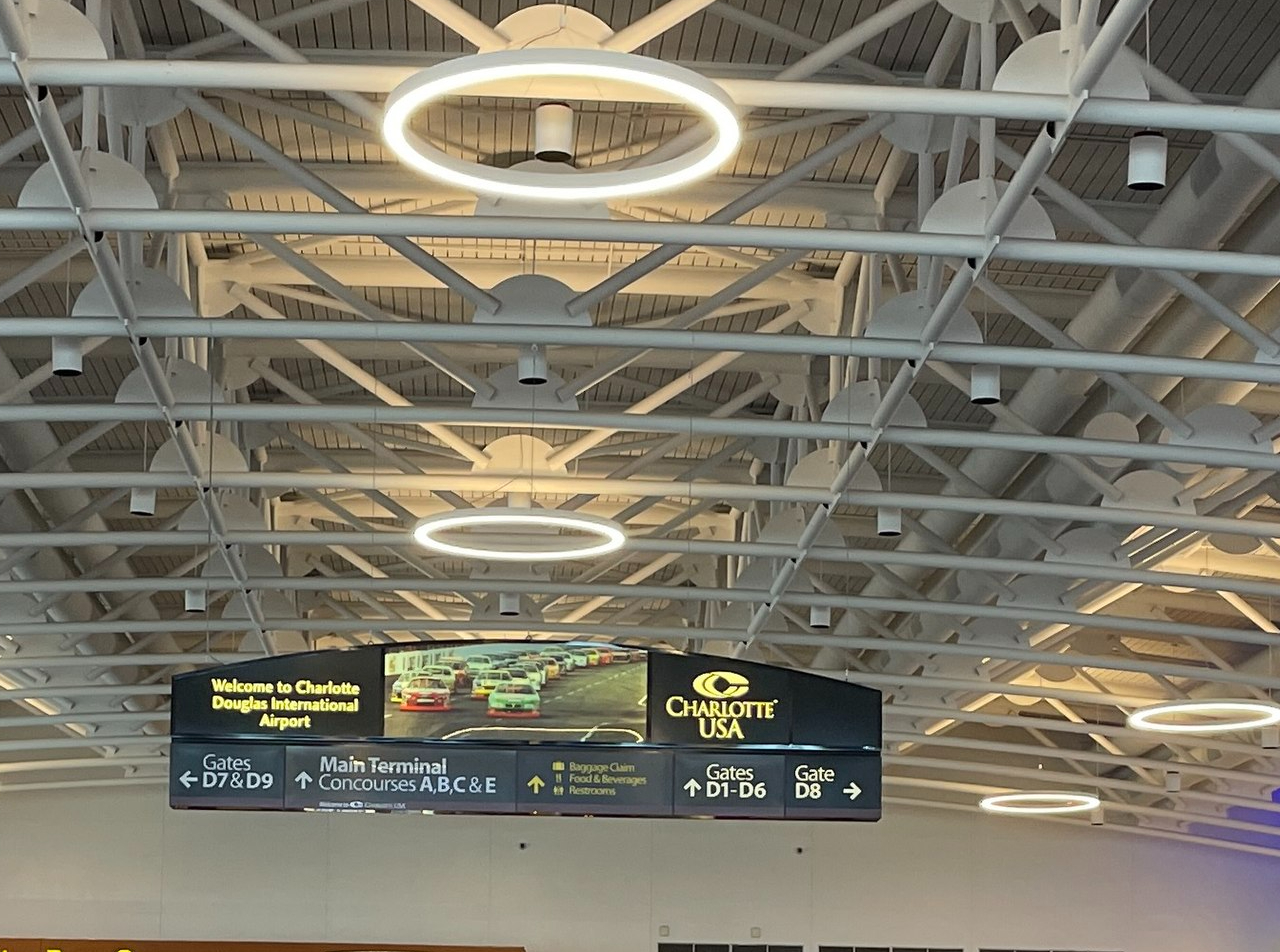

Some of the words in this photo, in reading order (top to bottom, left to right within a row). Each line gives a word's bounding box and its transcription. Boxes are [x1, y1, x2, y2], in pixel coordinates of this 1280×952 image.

[211, 678, 274, 694] Welcome
[277, 680, 293, 694] to
[295, 679, 361, 695] Charlotte
[211, 695, 268, 714] Douglas
[271, 696, 359, 712] International
[259, 713, 311, 731] Airport
[698, 717, 745, 740] USA
[202, 753, 251, 771] Gates
[320, 755, 366, 774] Main
[368, 757, 447, 775] Terminal
[569, 762, 609, 774] Baggage
[610, 762, 635, 772] Claim
[569, 774, 593, 784] Food
[594, 774, 601, 784] &
[602, 774, 647, 787] Beverages
[706, 763, 754, 781] Gates
[794, 764, 836, 783] Gate
[318, 773, 416, 792] Concourses
[569, 786, 616, 796] Restrooms
[706, 781, 767, 799] D1-D6
[795, 782, 822, 799] D8
